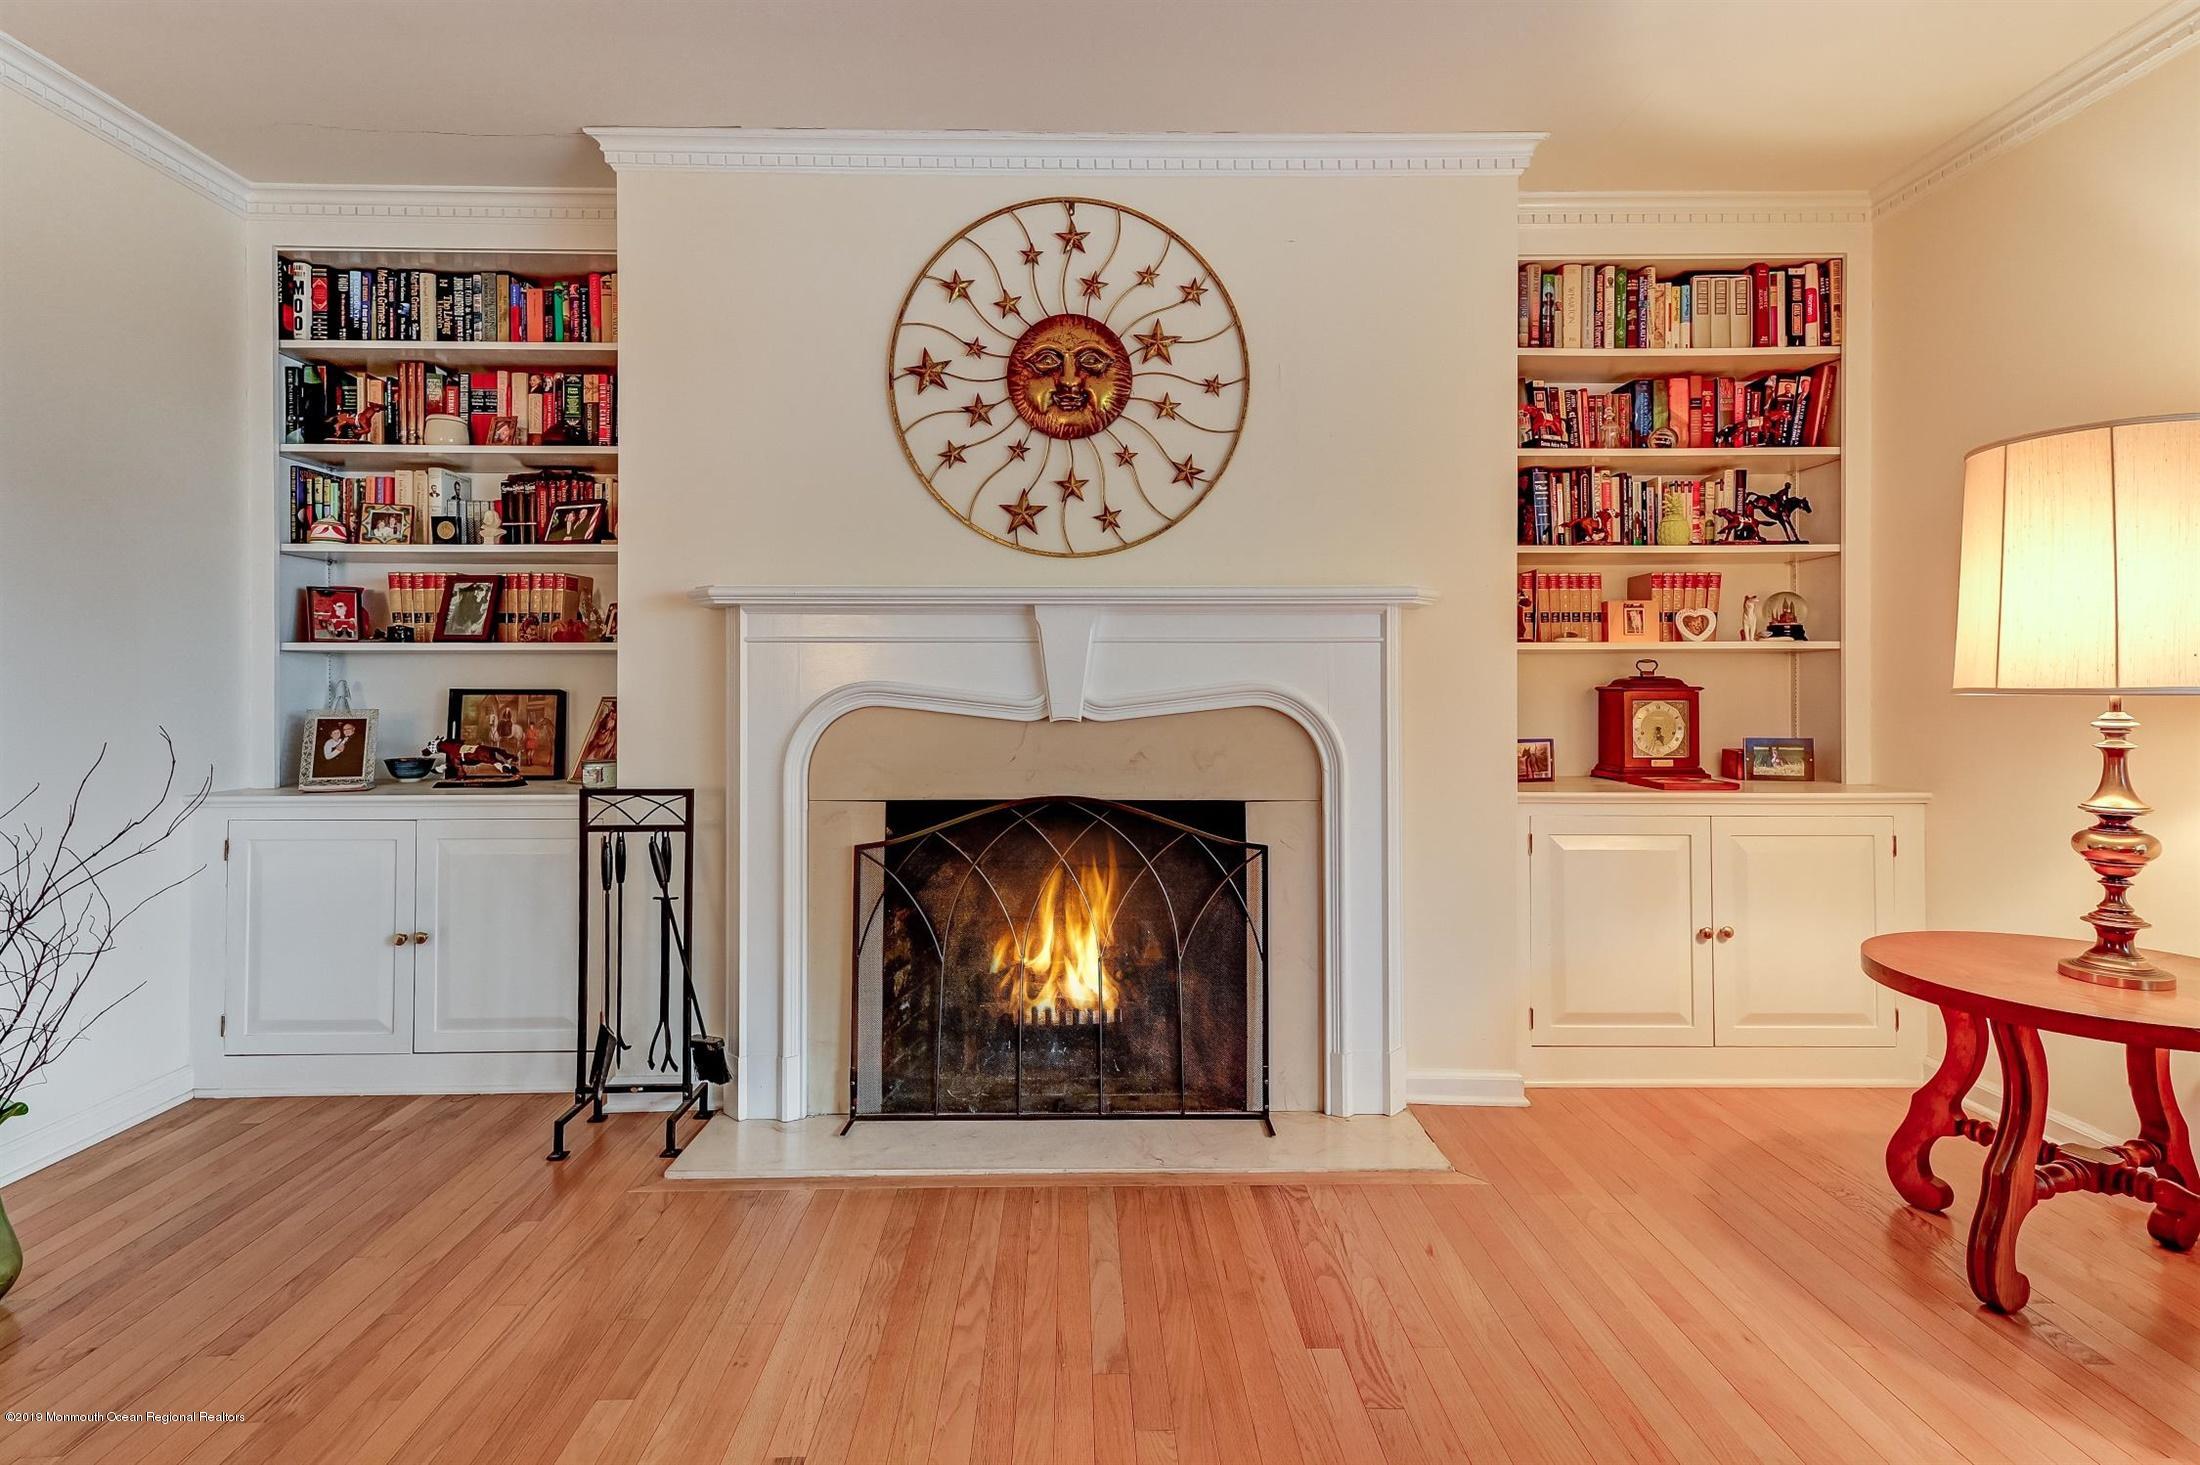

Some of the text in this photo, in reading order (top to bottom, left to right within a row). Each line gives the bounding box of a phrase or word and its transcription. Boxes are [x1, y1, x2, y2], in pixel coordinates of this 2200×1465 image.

[377, 270, 388, 323] Martha Grimes
[411, 272, 419, 296] Martha
[454, 277, 464, 315] JOHN SANDFORD
[442, 295, 452, 335] The Living
[1568, 287, 1576, 324] WHARTON
[1794, 421, 1802, 445] GERGEN
